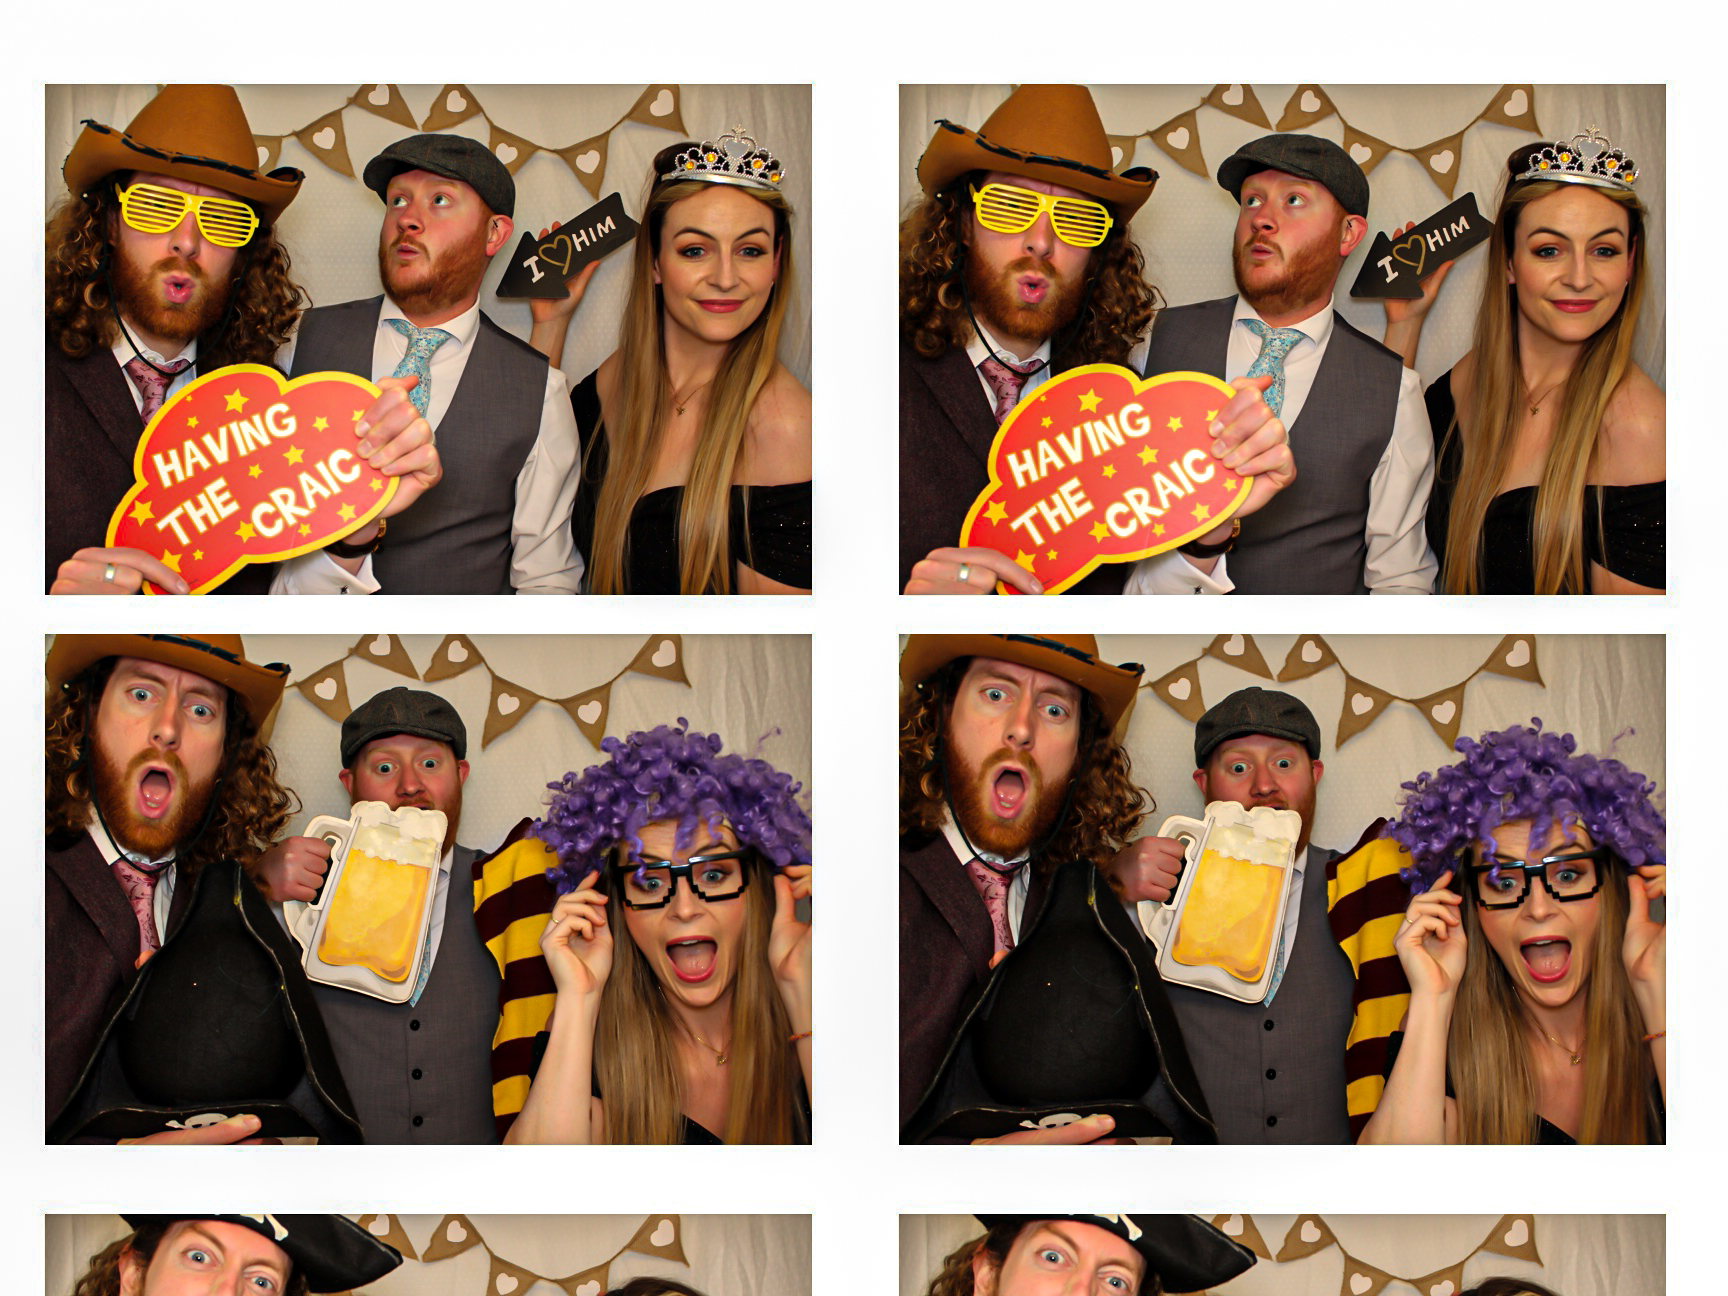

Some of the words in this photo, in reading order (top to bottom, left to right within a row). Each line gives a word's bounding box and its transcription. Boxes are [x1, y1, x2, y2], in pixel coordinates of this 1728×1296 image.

[522, 255, 545, 284] I
[571, 215, 617, 252] HIM
[1376, 255, 1399, 284] I
[1425, 215, 1471, 252] HIM
[152, 402, 297, 489] HAVING
[1006, 402, 1151, 489] HAVING
[155, 476, 241, 547] THE
[251, 448, 362, 539] CRAIC
[1009, 476, 1095, 547] THE
[1105, 448, 1216, 539] CRAIC
